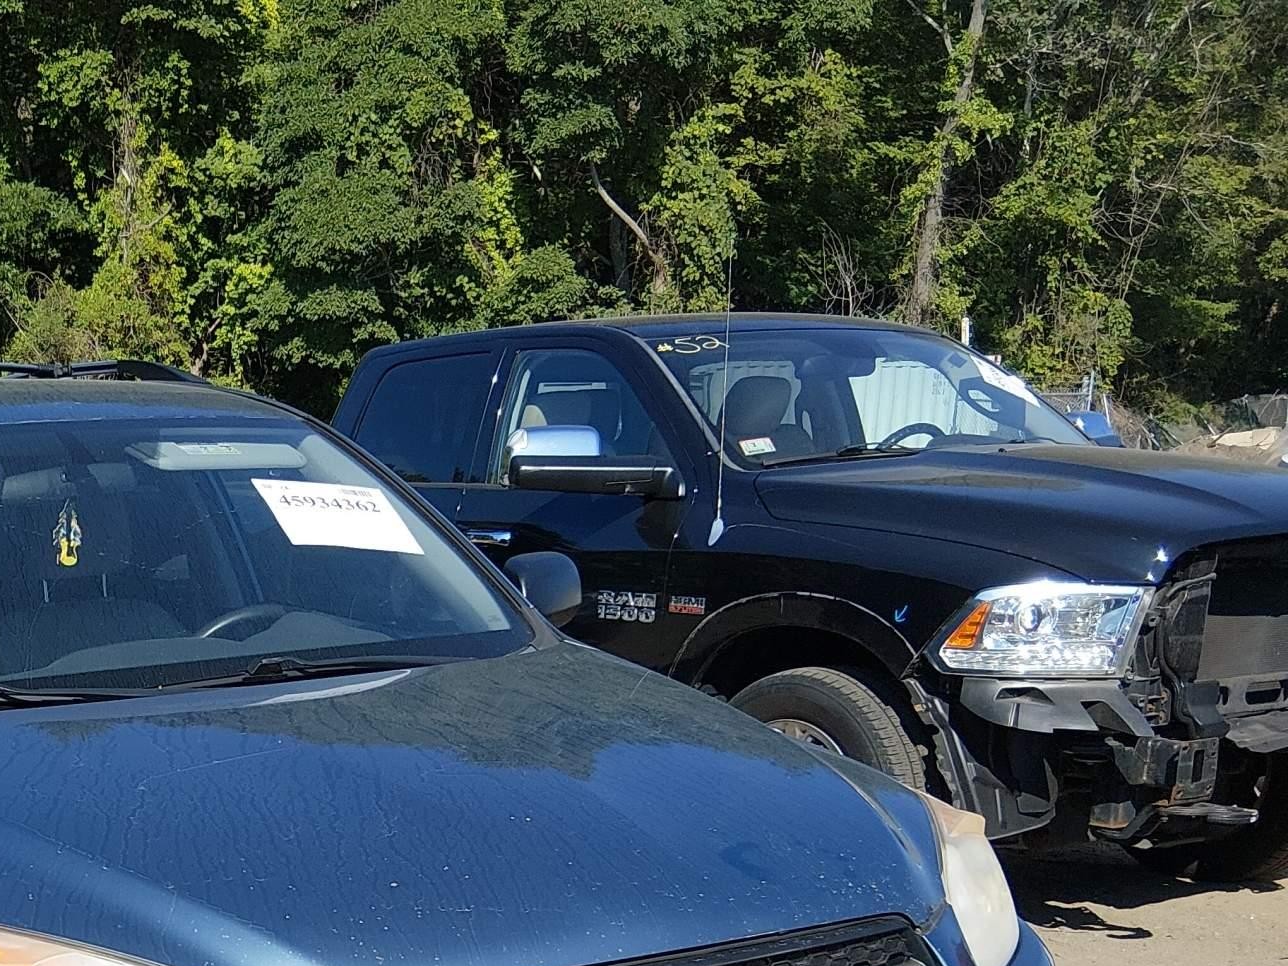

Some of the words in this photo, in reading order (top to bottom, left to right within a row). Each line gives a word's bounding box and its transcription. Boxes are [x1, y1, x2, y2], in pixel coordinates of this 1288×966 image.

[279, 494, 381, 513] 45934362
[597, 590, 657, 608] RAM
[597, 605, 656, 623] 1500
